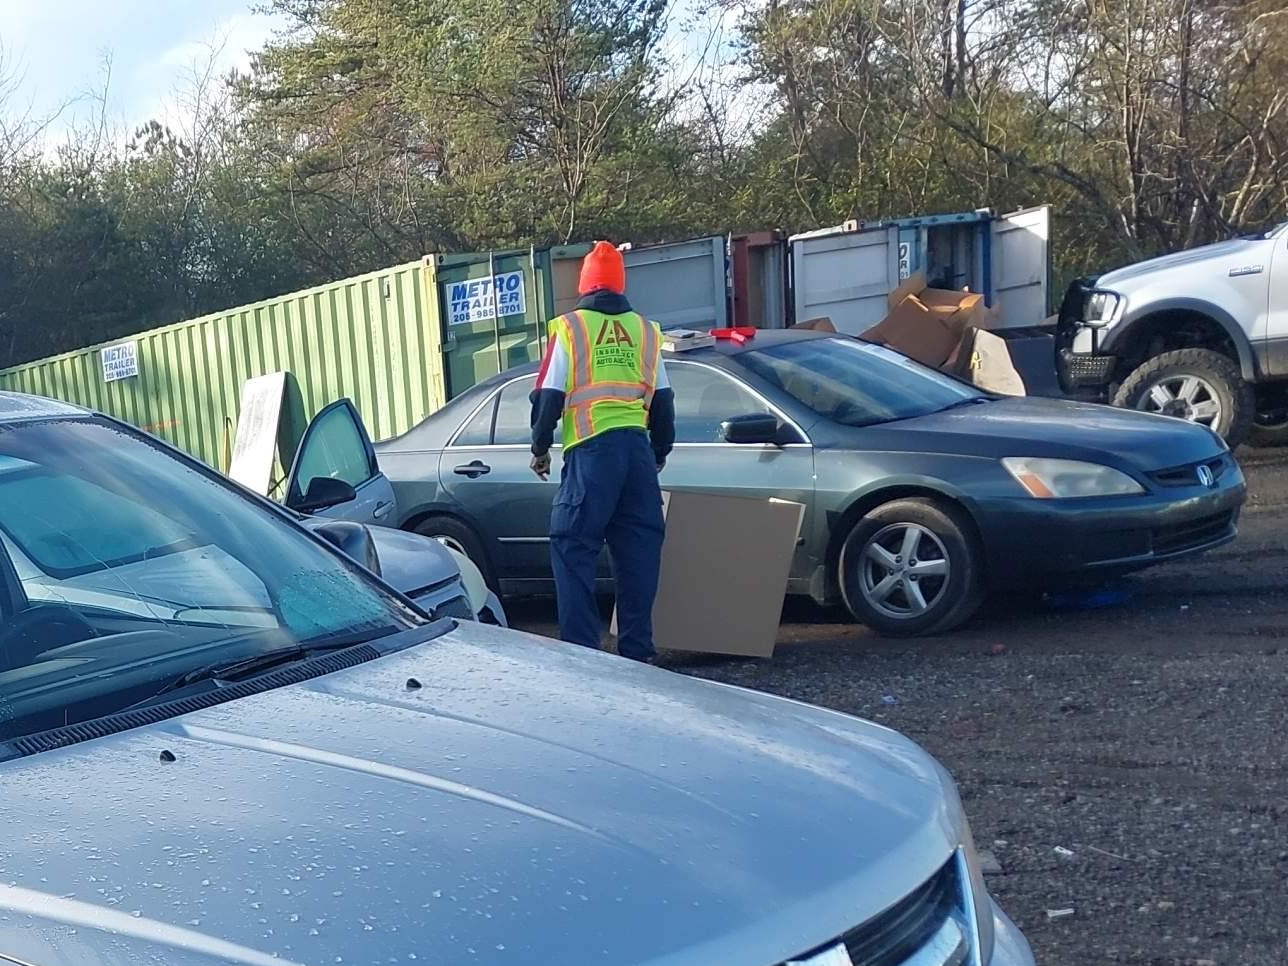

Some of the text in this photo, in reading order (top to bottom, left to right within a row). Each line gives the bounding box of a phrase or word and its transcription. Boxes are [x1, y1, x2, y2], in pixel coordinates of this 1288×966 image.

[452, 275, 520, 301] METRO
[452, 292, 519, 312] TRAILER
[104, 344, 134, 362] METRO
[104, 357, 135, 372] TRAILER
